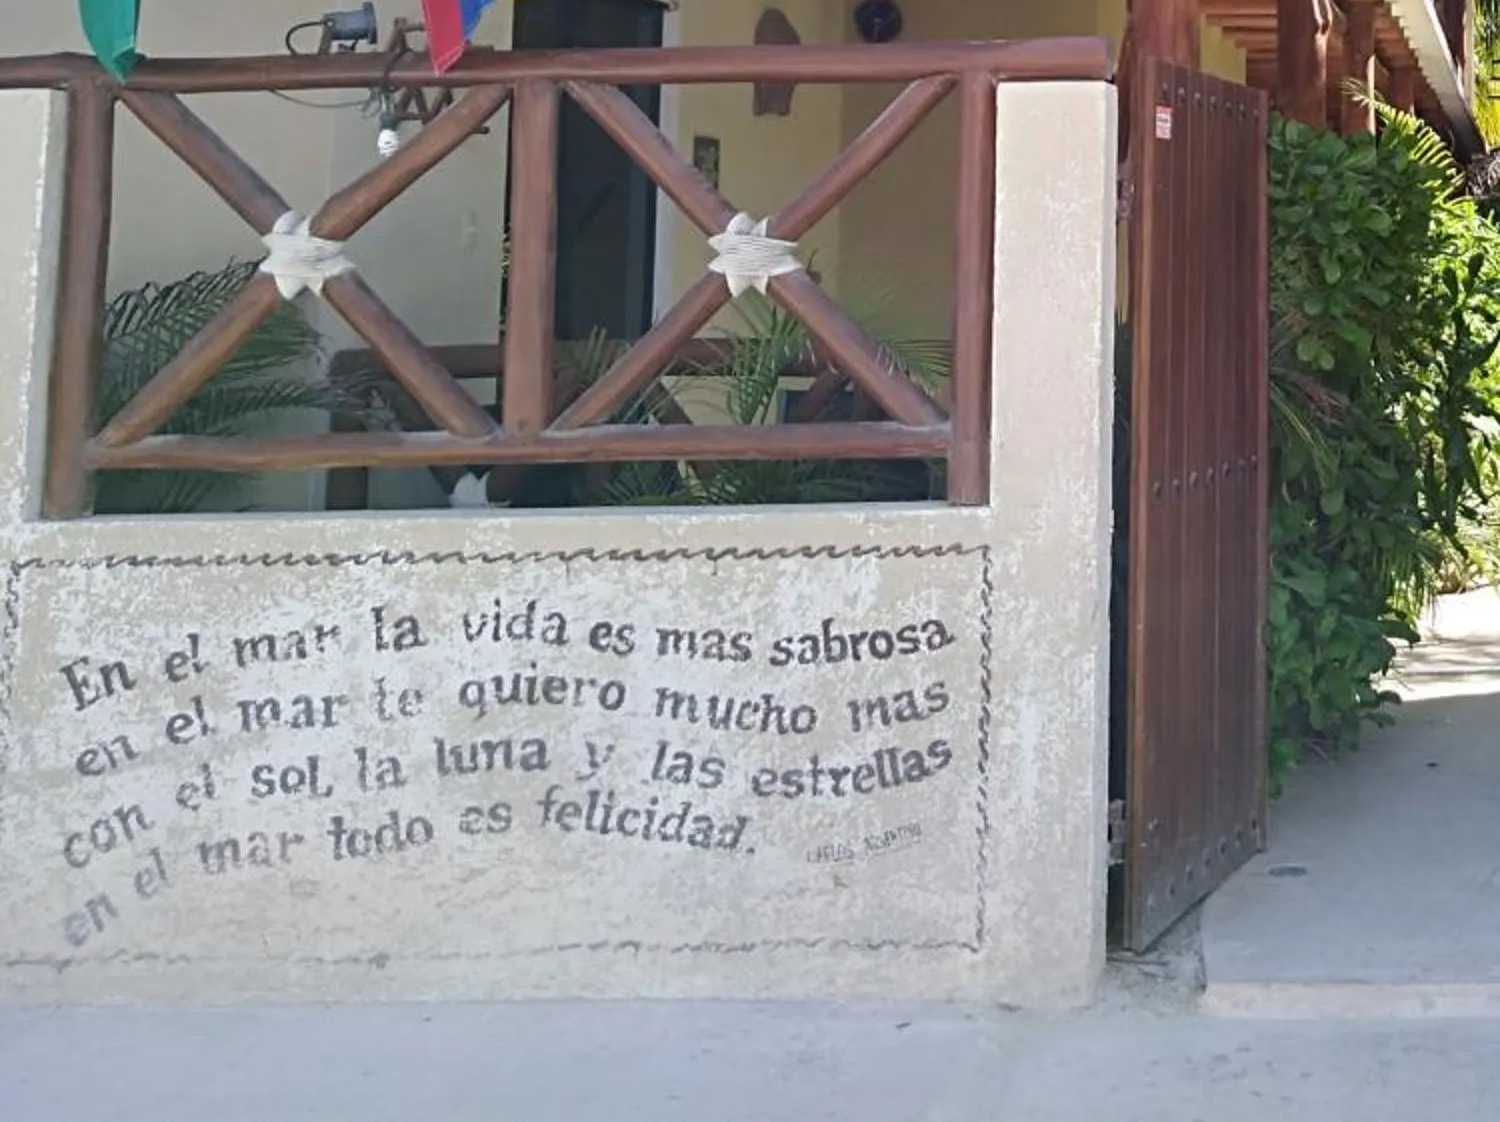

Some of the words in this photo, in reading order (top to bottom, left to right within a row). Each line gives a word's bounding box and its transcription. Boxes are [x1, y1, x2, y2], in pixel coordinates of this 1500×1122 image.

[59, 656, 138, 712] En
[164, 633, 209, 682] el
[232, 624, 341, 668] mar
[370, 605, 427, 652] la
[462, 599, 569, 646] vida
[589, 620, 636, 656] es
[655, 627, 752, 662] mas
[769, 617, 955, 666] sabrosa
[75, 735, 140, 776] en
[165, 695, 213, 745] el
[237, 693, 350, 732] mar
[370, 677, 424, 721] te
[458, 662, 627, 721] quiero
[655, 687, 818, 735] mucho
[847, 680, 951, 732] mas
[63, 803, 155, 869] con
[175, 762, 216, 811] el
[353, 746, 407, 793] la
[434, 736, 551, 776] luna
[575, 740, 616, 780] y
[652, 740, 726, 789] las
[751, 739, 953, 799] estrellas
[61, 892, 119, 947] en
[133, 846, 171, 899] el
[199, 830, 304, 875] mar
[326, 810, 434, 861] todo
[459, 801, 512, 835] es
[536, 783, 756, 854] felicidad.
